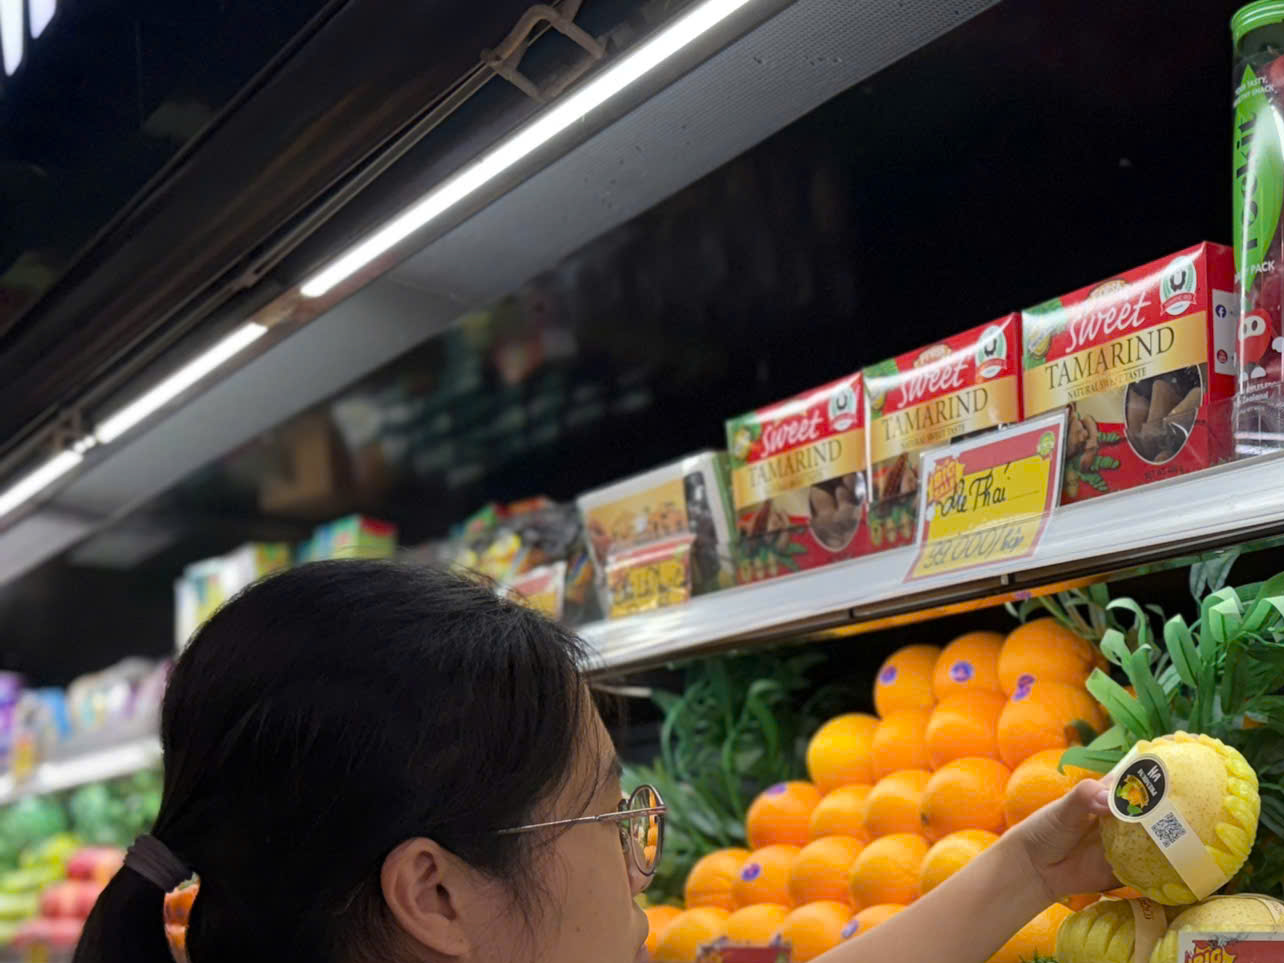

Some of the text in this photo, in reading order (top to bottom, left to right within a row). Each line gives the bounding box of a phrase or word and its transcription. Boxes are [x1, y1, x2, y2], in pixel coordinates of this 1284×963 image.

[1250, 260, 1276, 275] PACK
[1066, 292, 1151, 353] sweet
[897, 357, 969, 409] sweet
[1045, 326, 1176, 391] TAMARIND
[760, 408, 825, 458] sweet
[881, 387, 989, 441] TAMARIND
[750, 438, 843, 488] TAMARIND
